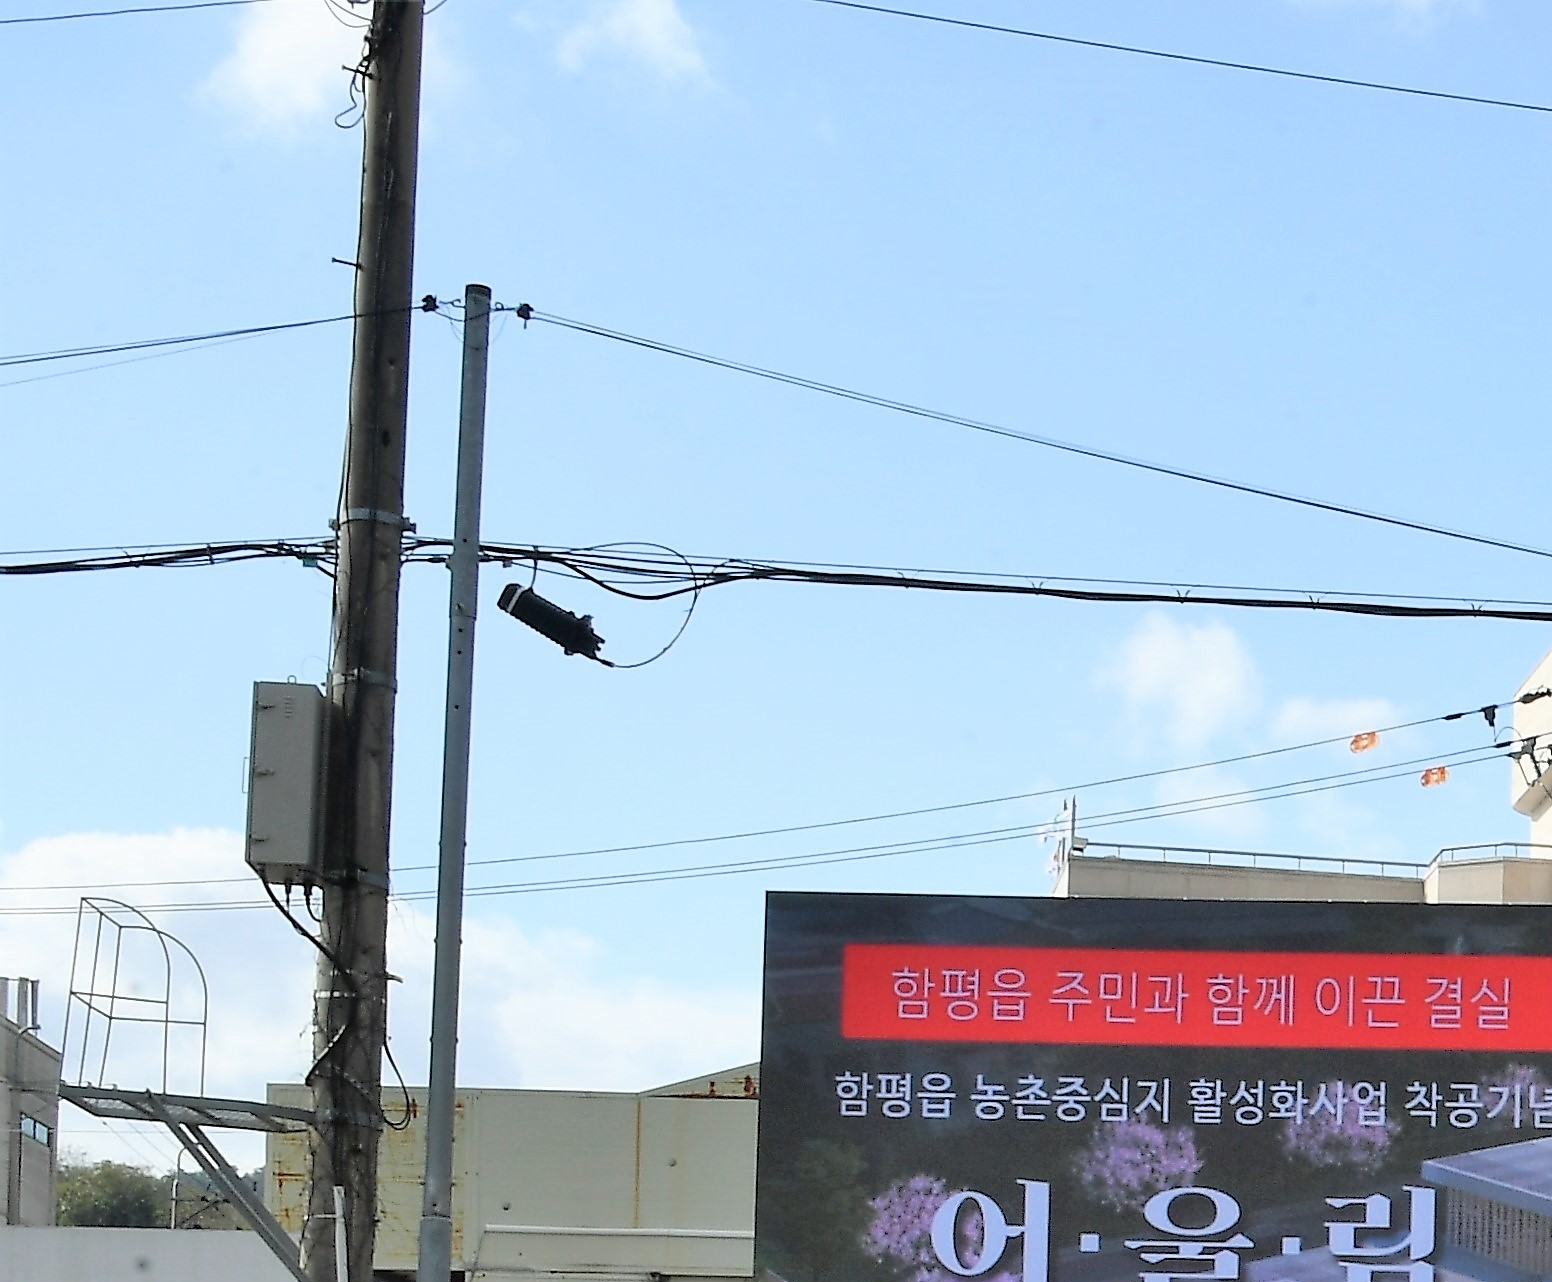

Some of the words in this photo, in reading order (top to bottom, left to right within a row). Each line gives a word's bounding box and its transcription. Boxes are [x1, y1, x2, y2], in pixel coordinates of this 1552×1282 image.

[891, 968, 1032, 1022] 함평읍
[1048, 970, 1188, 1025] 주민과
[1206, 973, 1297, 1027] 함께
[1315, 975, 1406, 1028] 이끈
[1424, 976, 1513, 1031] 결실
[834, 1071, 957, 1121] 함평읍
[970, 1073, 1171, 1125] 농촌중심지
[1187, 1077, 1389, 1128] 활성화사업
